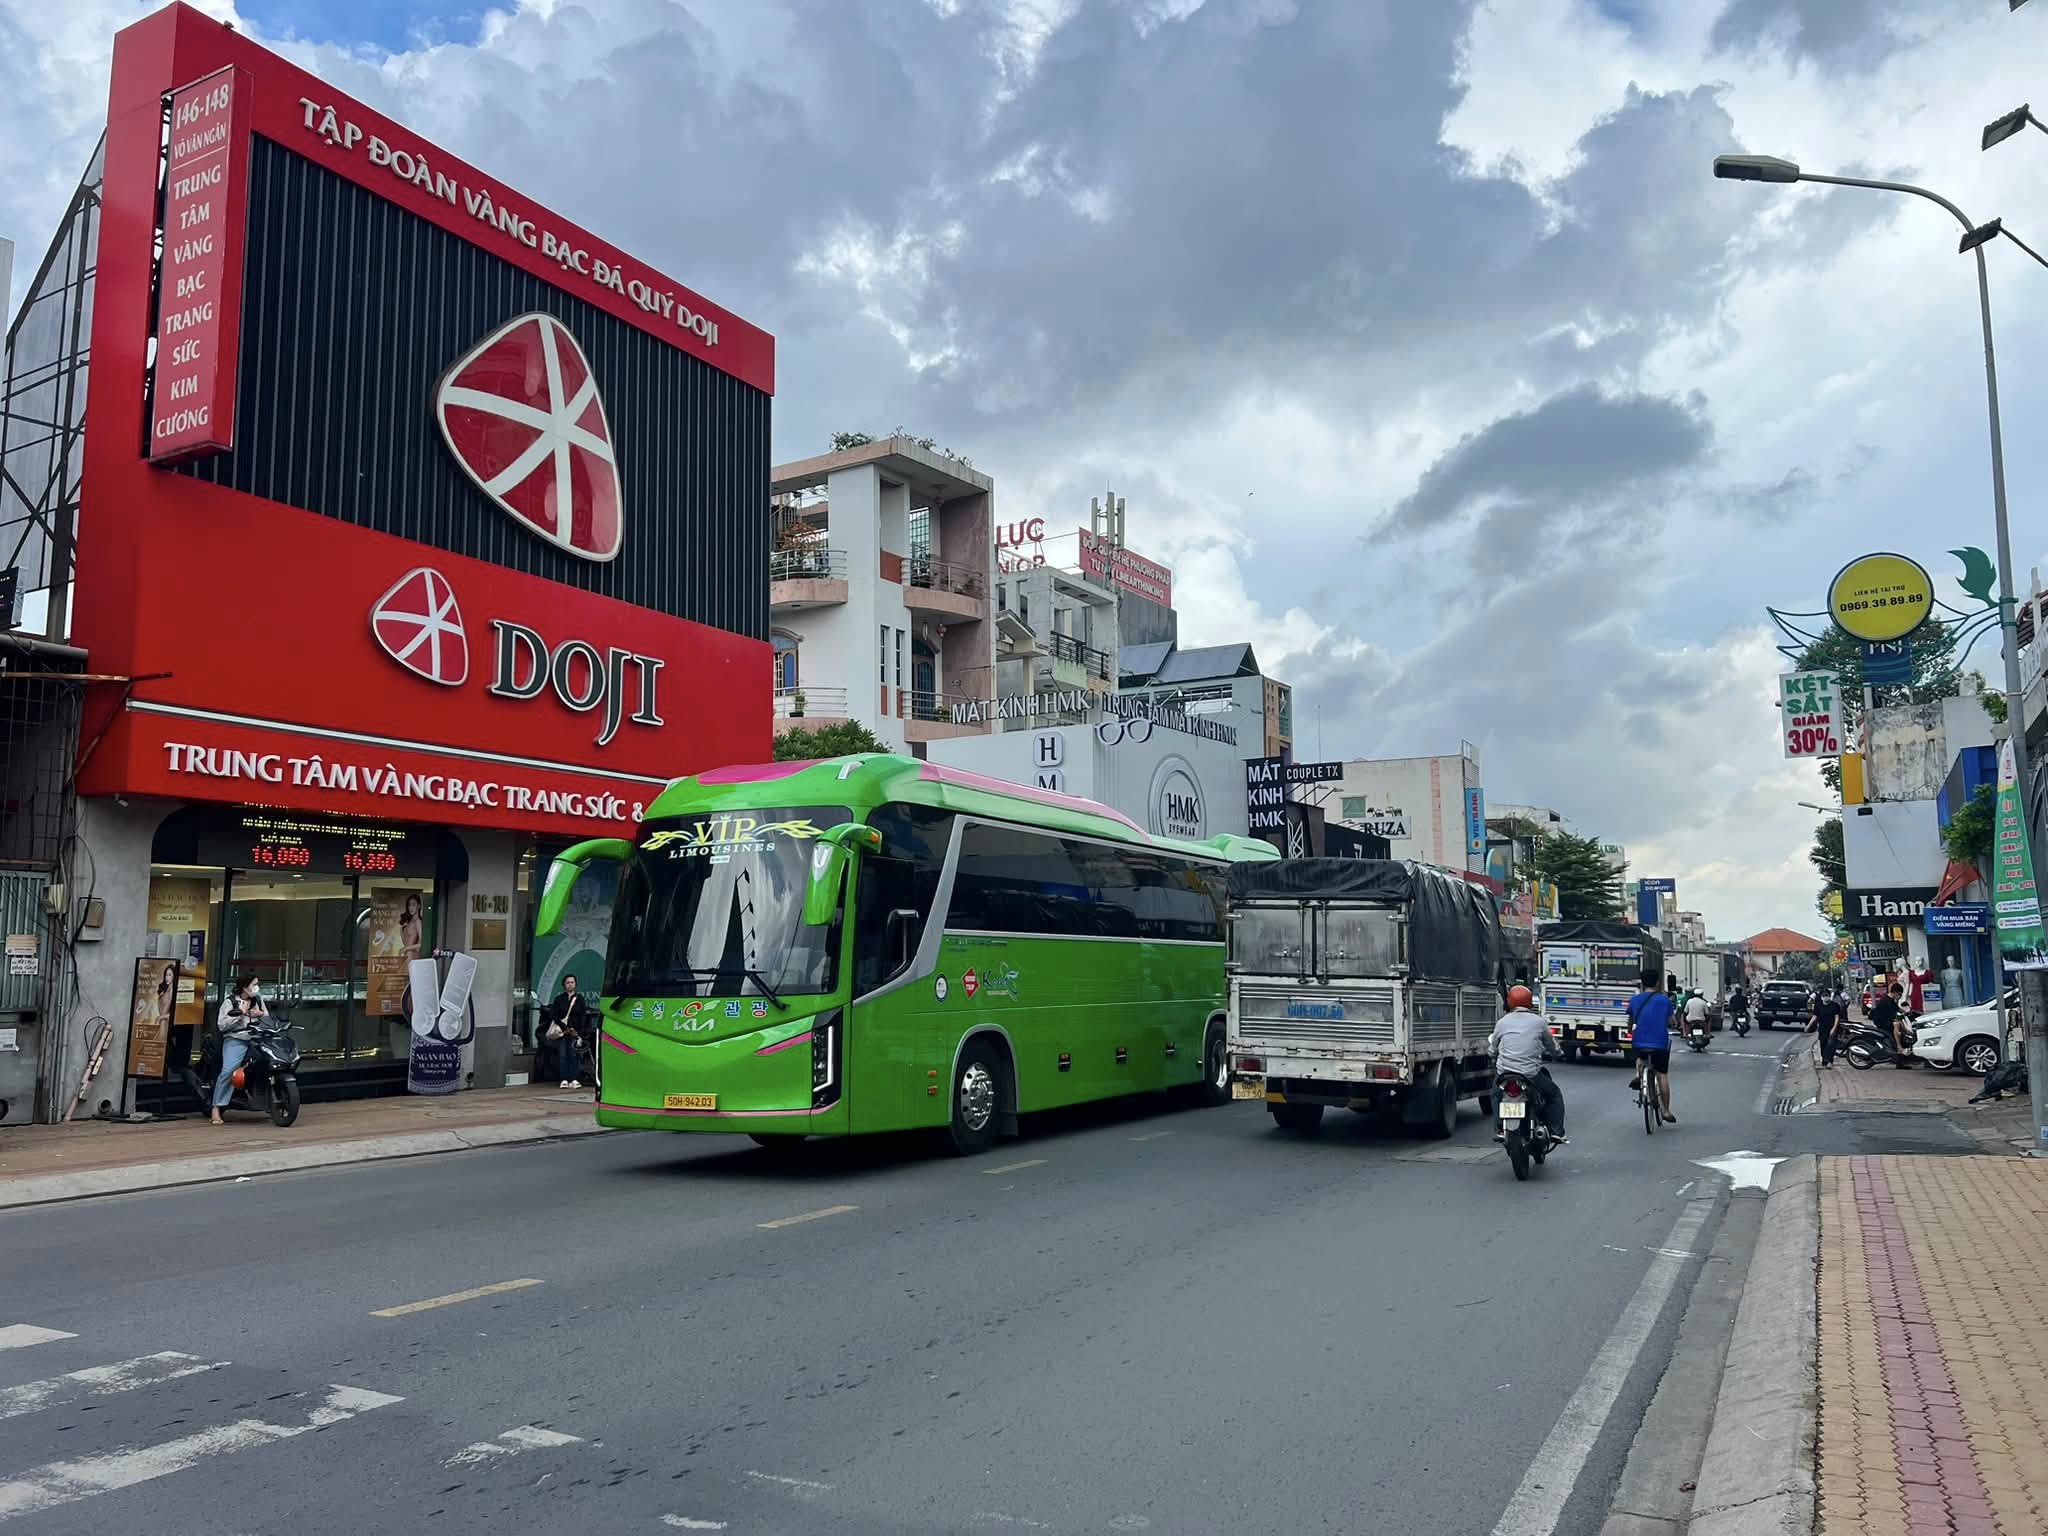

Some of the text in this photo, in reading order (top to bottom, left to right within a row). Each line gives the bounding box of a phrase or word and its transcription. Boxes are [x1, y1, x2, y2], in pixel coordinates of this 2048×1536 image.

[176, 84, 229, 130] 146-148
[174, 138, 186, 159] VÕ
[203, 121, 227, 147] NGÂN
[174, 164, 222, 201] TRUNG
[180, 202, 210, 231] TÂM
[299, 97, 719, 346] TẬP ĐOÀN VÀNG BẠC ĐÁ QUÝ DOJI
[173, 234, 213, 265] VÀNG
[176, 270, 206, 299] BẠC
[165, 302, 213, 335] TRANG
[172, 339, 201, 367] SỨC
[170, 374, 199, 401] KIM
[156, 407, 209, 439] CƯƠNG
[996, 517, 1045, 550] LỰC
[1840, 593, 1923, 612] 0969.39.89.89
[488, 619, 664, 746] DOJI
[1785, 674, 1830, 694] KÉT
[996, 693, 1040, 719] KÍNH
[1044, 690, 1092, 714] HMK
[1786, 692, 1832, 714] SẮT
[1788, 727, 1837, 754] 30%
[164, 741, 283, 783] TRUNG
[288, 755, 358, 792] TÂM
[362, 762, 444, 801] VÀNG
[447, 779, 499, 811] BẠC
[502, 785, 586, 818] TRANG
[586, 791, 626, 822] SỨC
[1248, 760, 1281, 783] MẮT
[1286, 765, 1339, 781] COUPLE TX
[1167, 792, 1200, 824] HMK
[1248, 785, 1284, 806] KÍNH
[693, 818, 756, 845] VIP
[1248, 810, 1285, 828] HMK
[668, 842, 776, 859] LIMOUSINES
[1861, 945, 1899, 959] Hames
[673, 1018, 715, 1031] KIA
